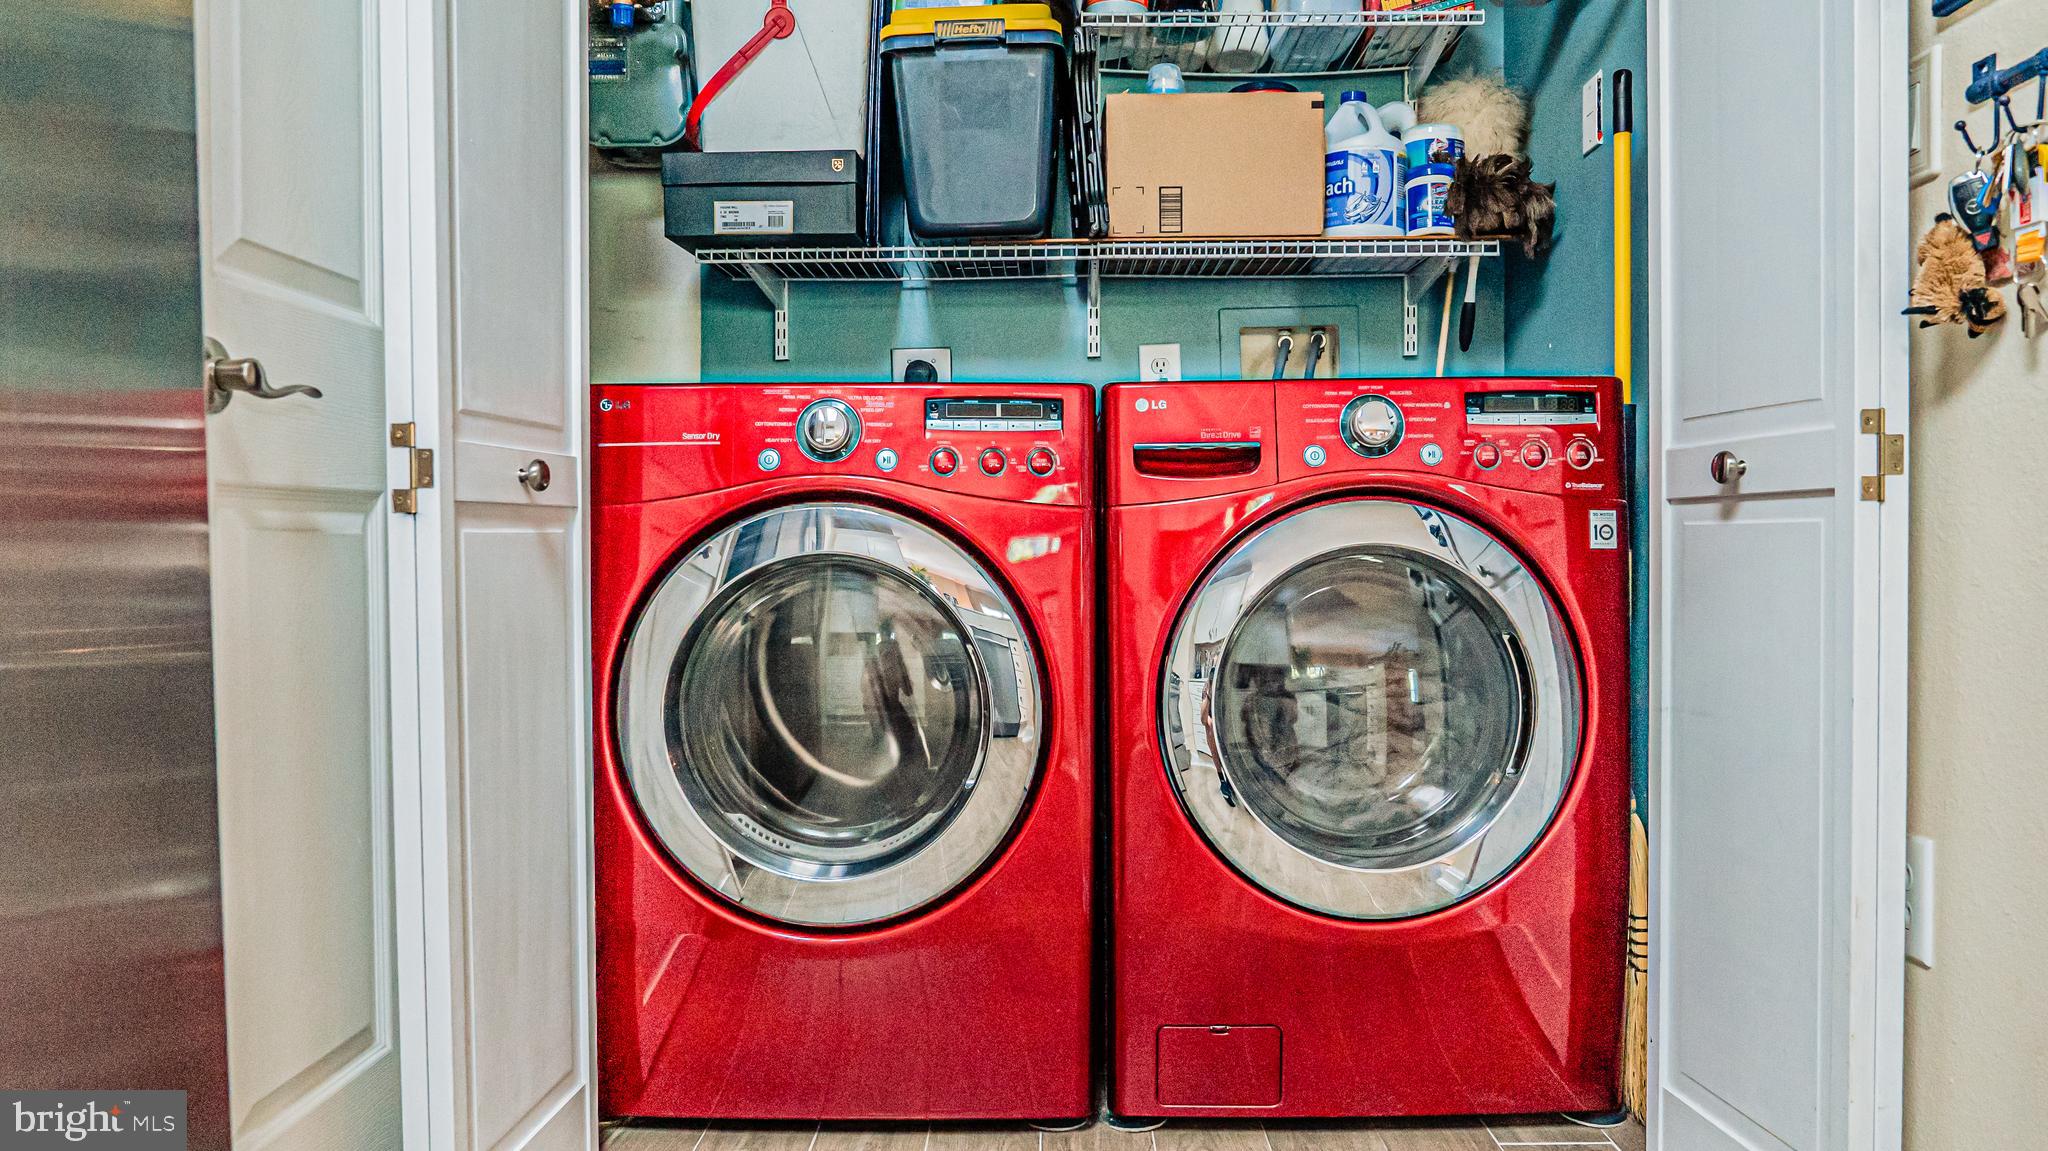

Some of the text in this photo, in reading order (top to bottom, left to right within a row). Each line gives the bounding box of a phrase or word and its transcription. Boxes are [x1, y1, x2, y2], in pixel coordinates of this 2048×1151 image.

[953, 24, 985, 35] Hefty
[1326, 177, 1353, 197] ach
[1151, 399, 1167, 410] LG
[682, 432, 721, 441] Sensor Dry
[1593, 523, 1614, 541] 10
